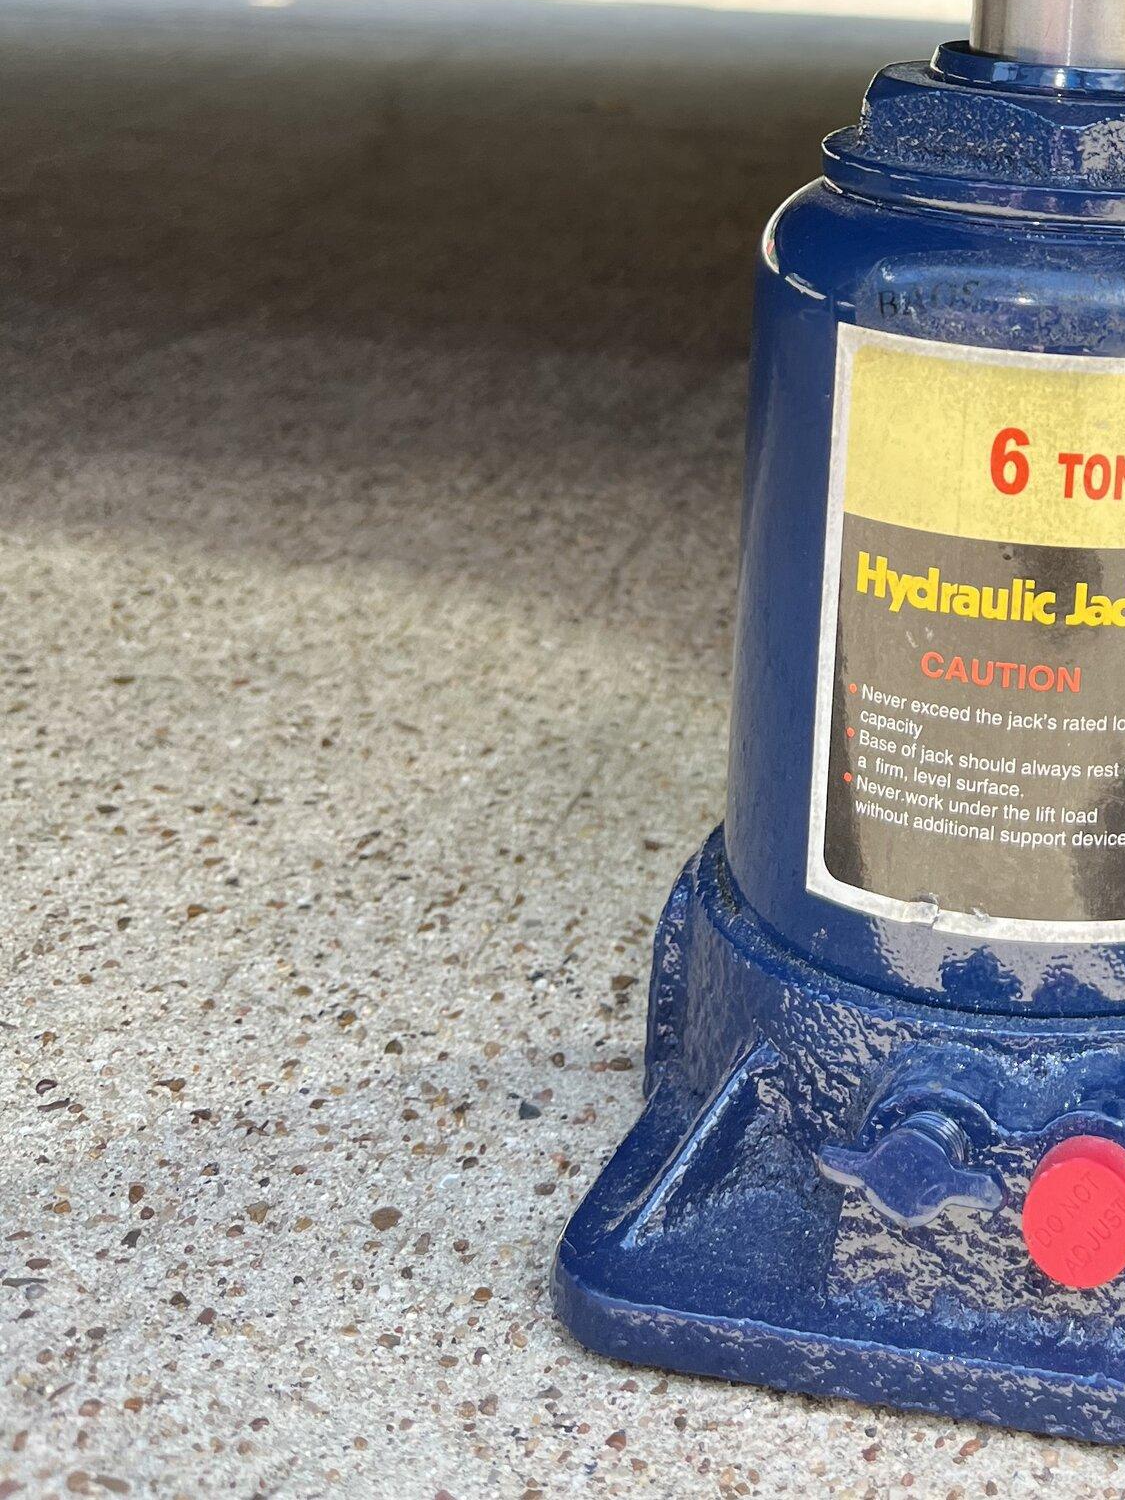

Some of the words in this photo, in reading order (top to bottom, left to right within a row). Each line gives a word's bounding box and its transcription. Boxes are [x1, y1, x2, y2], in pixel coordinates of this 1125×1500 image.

[990, 427, 1030, 495] 6
[856, 550, 1056, 625] Hydraulic
[920, 651, 1082, 693] CAUTION
[860, 710, 923, 739] capacity
[862, 684, 907, 709] Never
[911, 700, 970, 721] exceed
[976, 708, 1002, 725] the
[1006, 711, 1057, 730] jack's
[1062, 716, 1107, 731] rated
[857, 755, 867, 769] a
[875, 757, 908, 782] firm,
[913, 767, 951, 789] level
[956, 778, 1024, 797] surface.
[859, 730, 897, 753] Base
[901, 743, 917, 758] of
[920, 745, 953, 765] jack
[958, 753, 1016, 773] should
[1021, 760, 1081, 780] always
[1087, 762, 1119, 777] rest
[855, 799, 909, 826] without
[913, 816, 995, 840] additional
[1000, 828, 1066, 848] support
[949, 800, 999, 818] under
[1003, 804, 1030, 821] the
[1035, 806, 1056, 822] lift
[1061, 808, 1098, 823] load
[1033, 1214, 1064, 1248] DO
[1060, 1171, 1101, 1219] NOT
